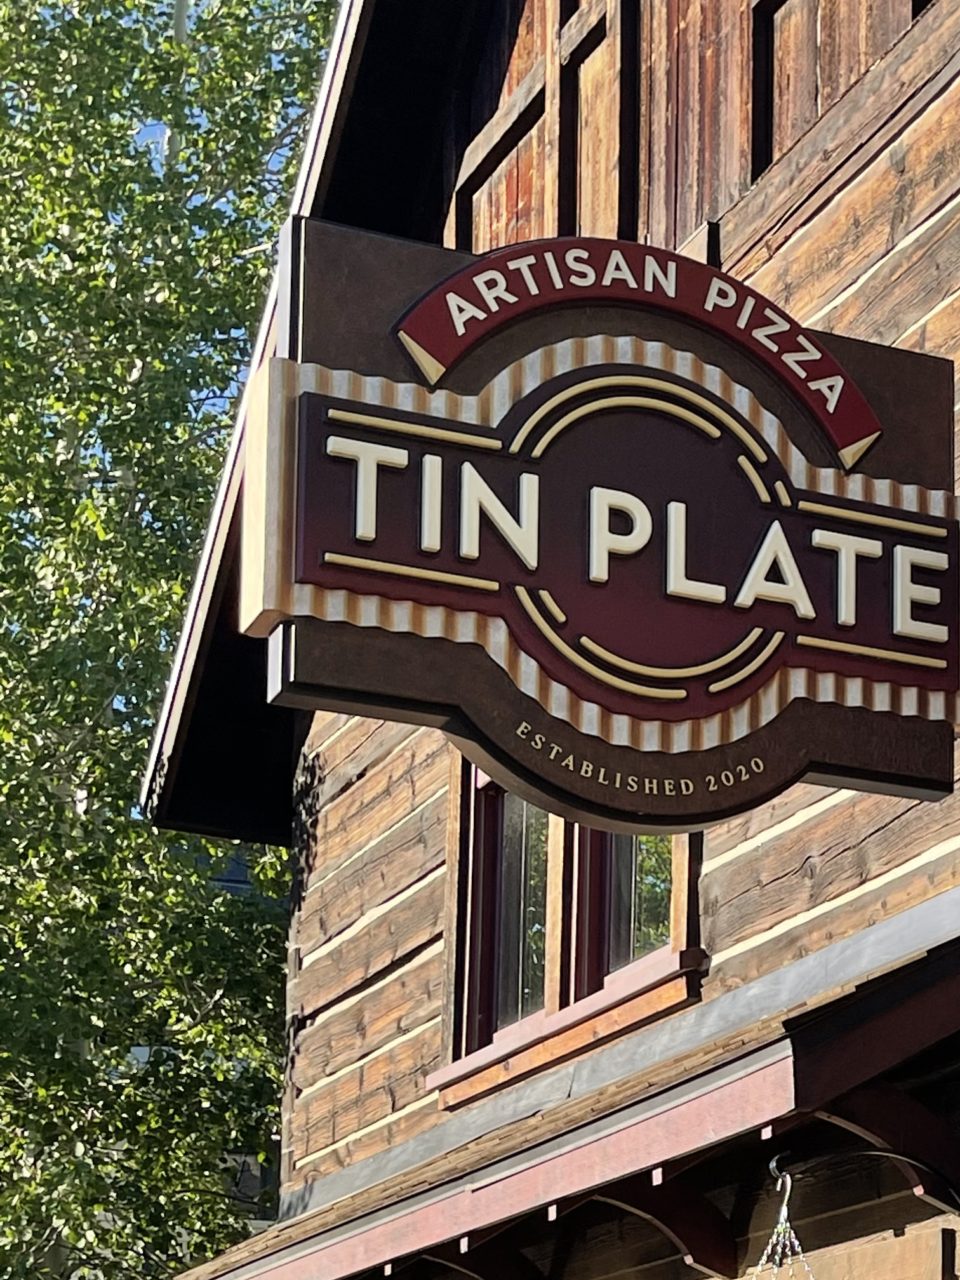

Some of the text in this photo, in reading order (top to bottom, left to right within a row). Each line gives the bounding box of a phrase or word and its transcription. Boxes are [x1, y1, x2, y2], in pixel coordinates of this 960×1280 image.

[445, 248, 846, 414] ARTISAN PIZZA
[326, 435, 949, 642] TIN PLATE
[516, 721, 765, 796] ESTABLISHED 2020
